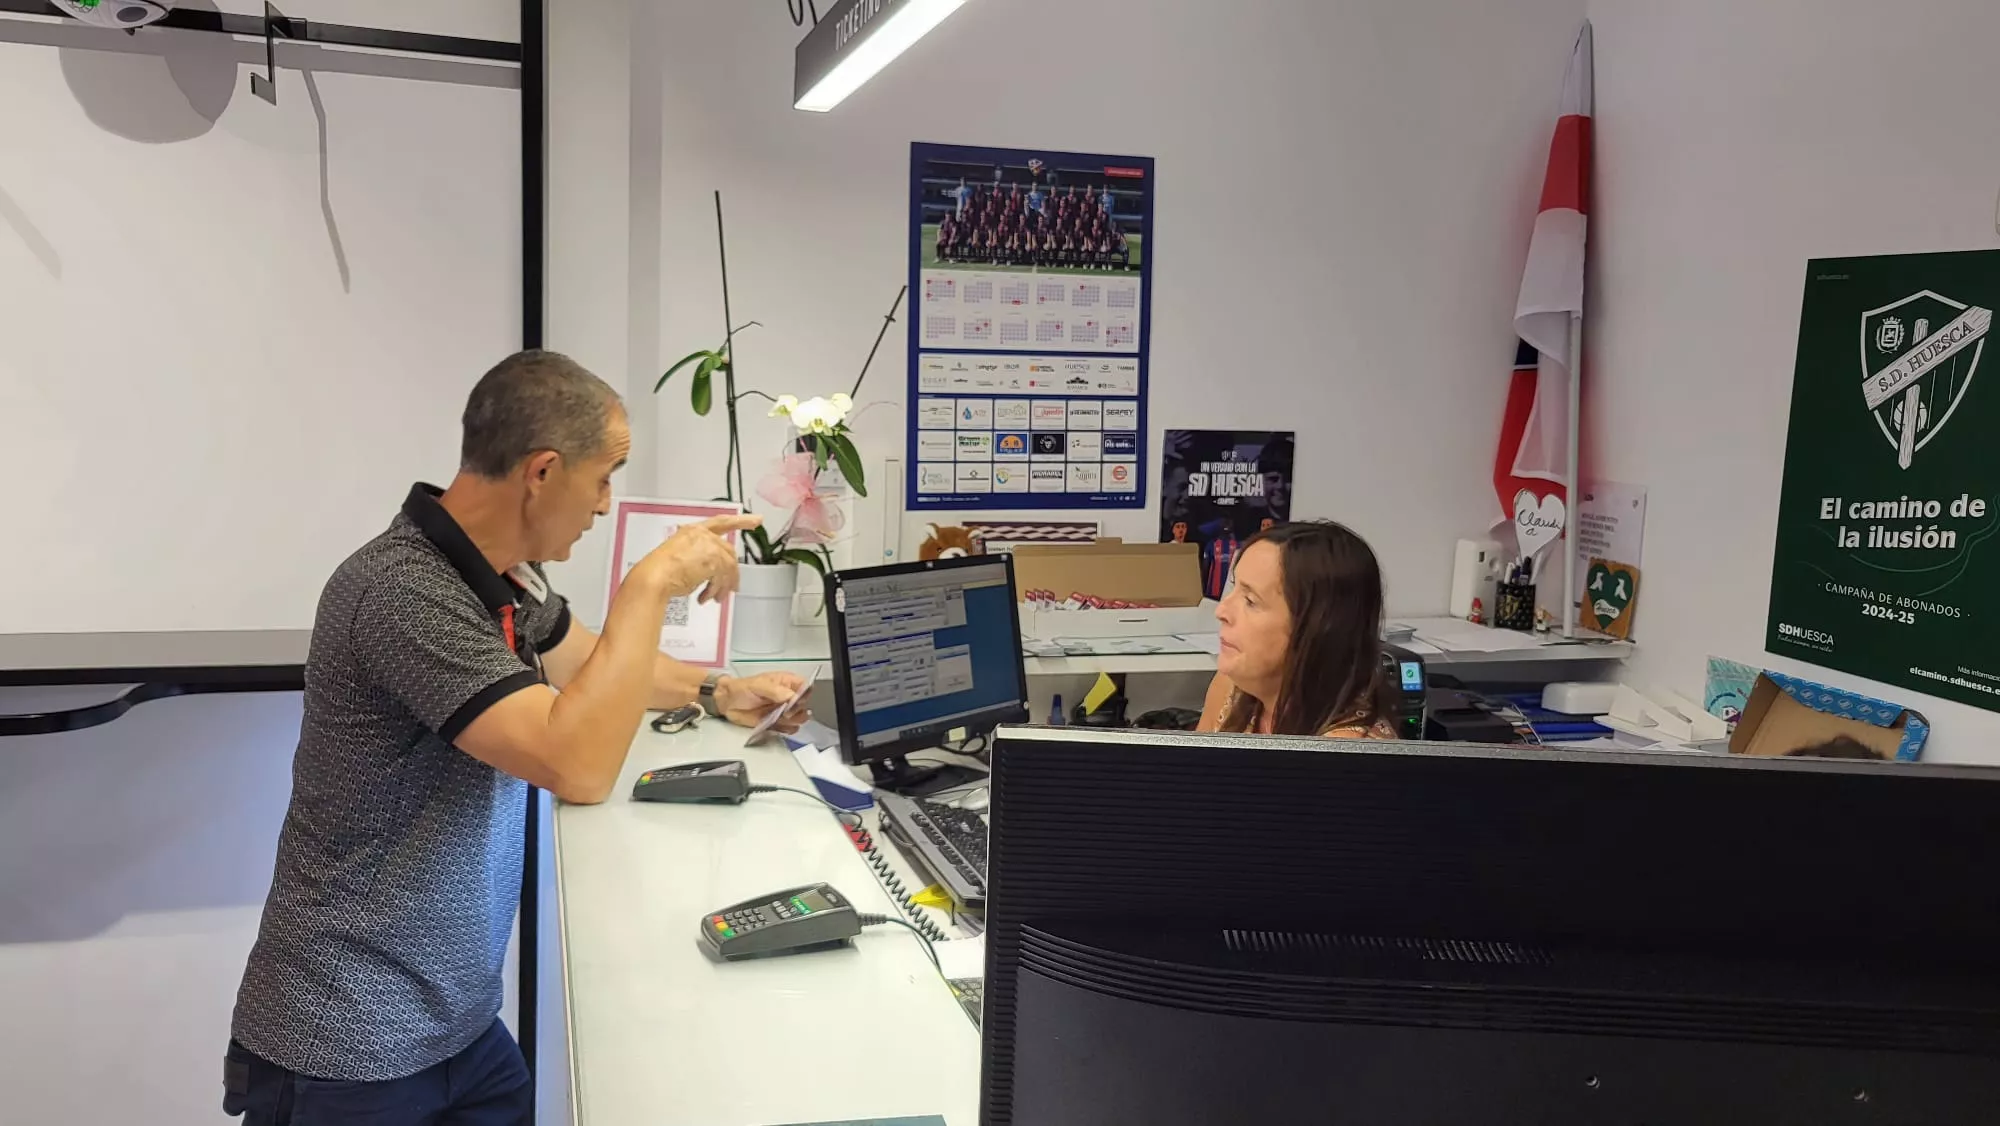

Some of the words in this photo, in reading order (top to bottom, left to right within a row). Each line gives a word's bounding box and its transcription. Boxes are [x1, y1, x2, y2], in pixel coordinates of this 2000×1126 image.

[1878, 367, 1908, 393] S.D.
[1907, 320, 1976, 373] HUESCA
[1188, 473, 1208, 497] SD
[1211, 473, 1264, 497] HUESCA
[1820, 497, 1842, 520] El
[1849, 495, 1941, 520] camino
[1950, 494, 1986, 518] de
[1838, 525, 1860, 548] la
[1867, 525, 1956, 549] ilusión
[1825, 582, 1875, 601] CAMPAÑA
[1878, 592, 1893, 605] DE
[1896, 596, 1961, 618] ABONADOS
[1862, 603, 1915, 625] 2024-25
[1778, 622, 1834, 646] SDHUESCA
